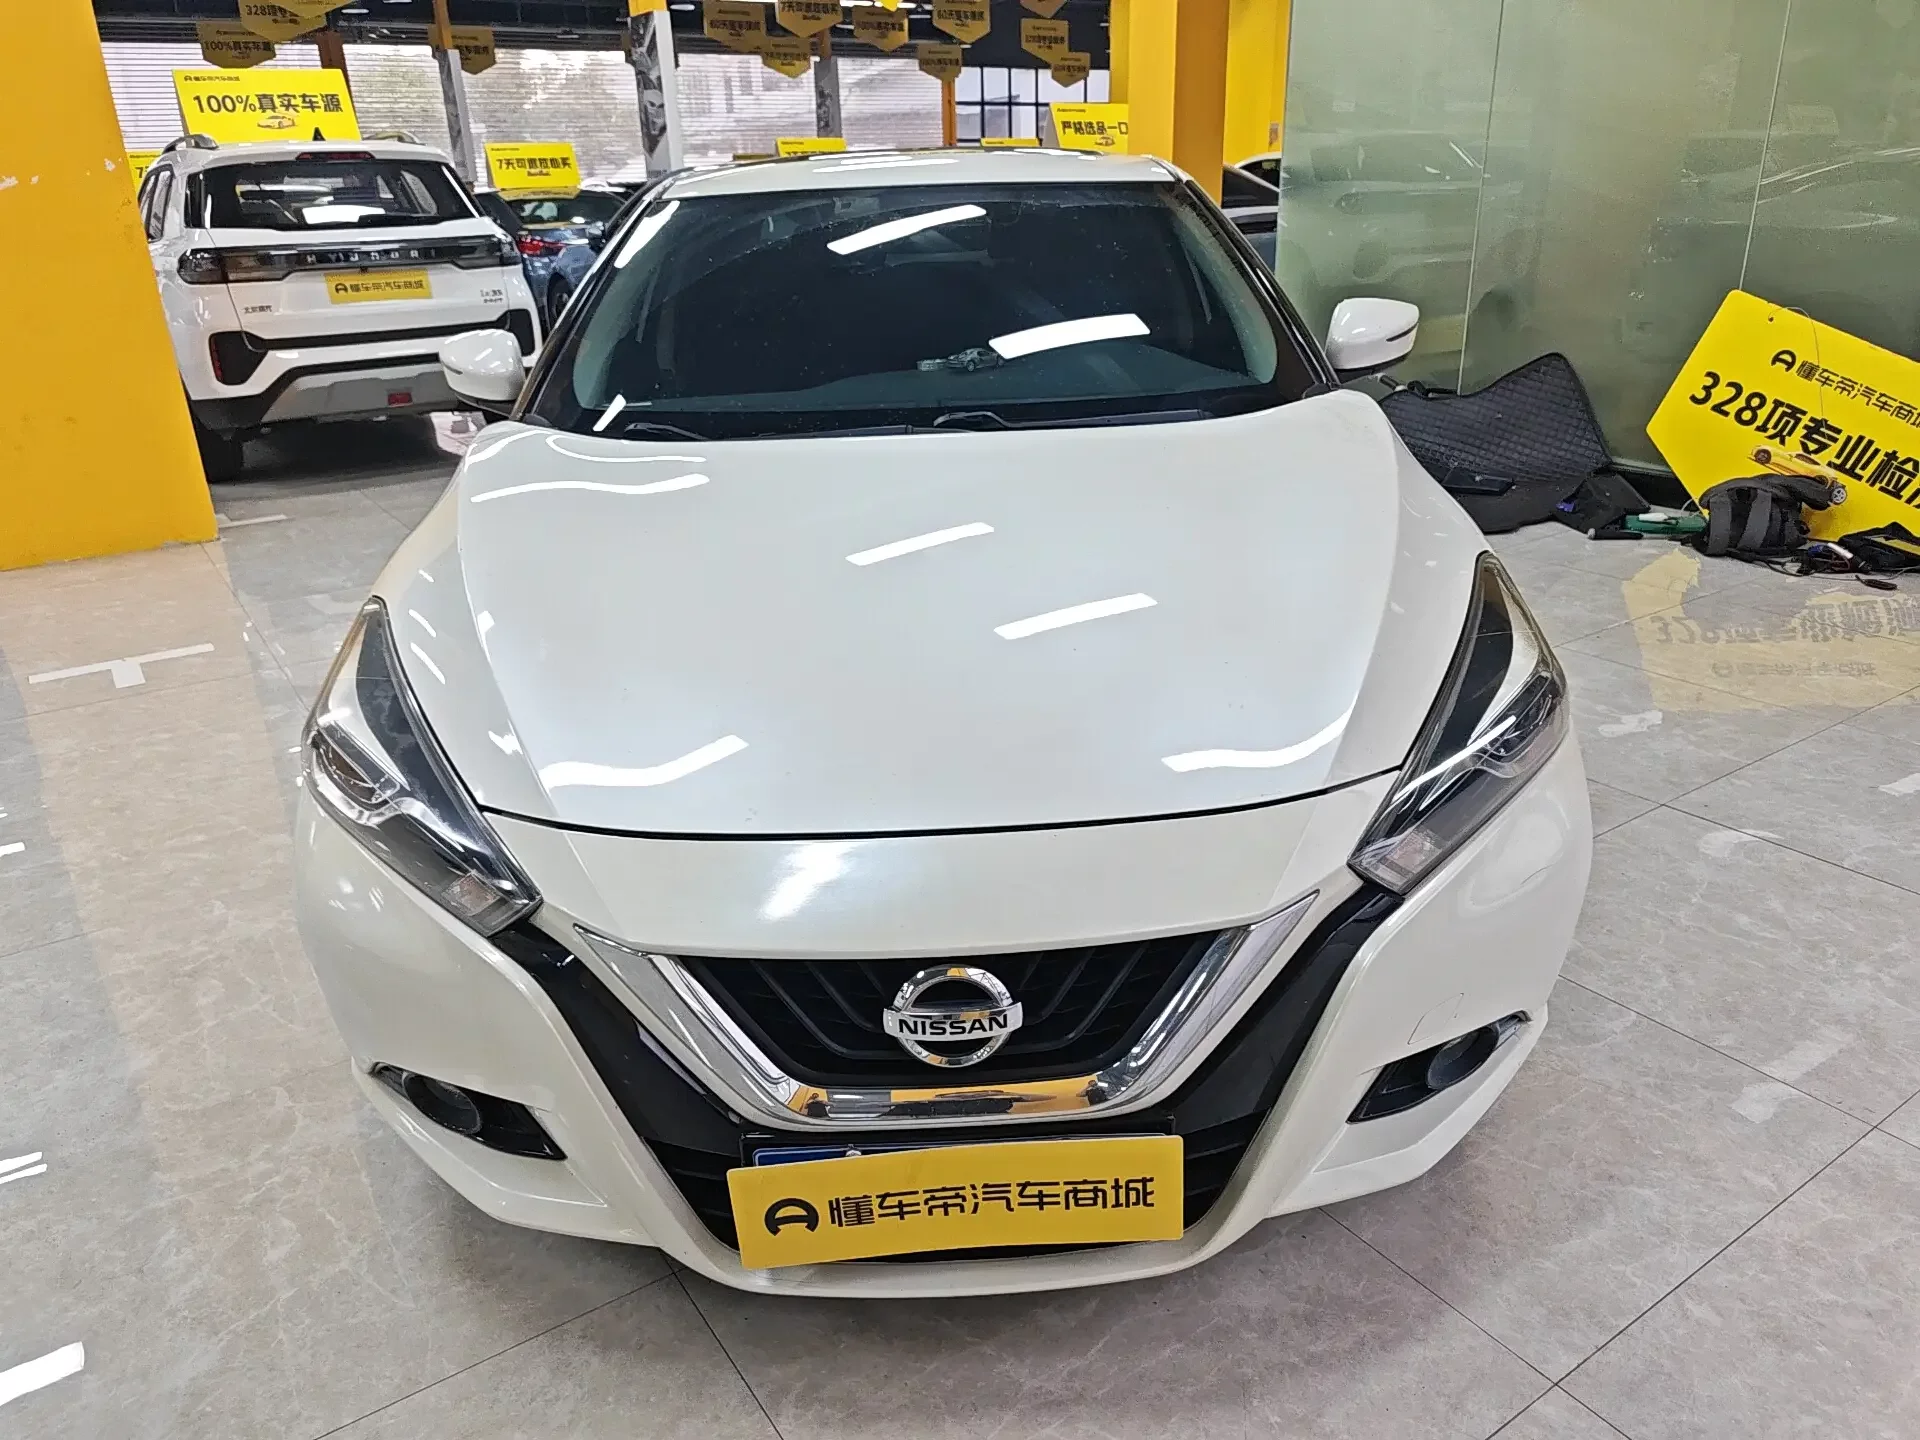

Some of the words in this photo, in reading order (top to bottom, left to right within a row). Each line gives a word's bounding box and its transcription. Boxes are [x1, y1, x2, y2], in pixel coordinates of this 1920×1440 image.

[193, 93, 343, 113] 100%真实车源
[898, 1013, 1008, 1036] NISSAN
[828, 1176, 1156, 1229] 懂车帝汽车商城
